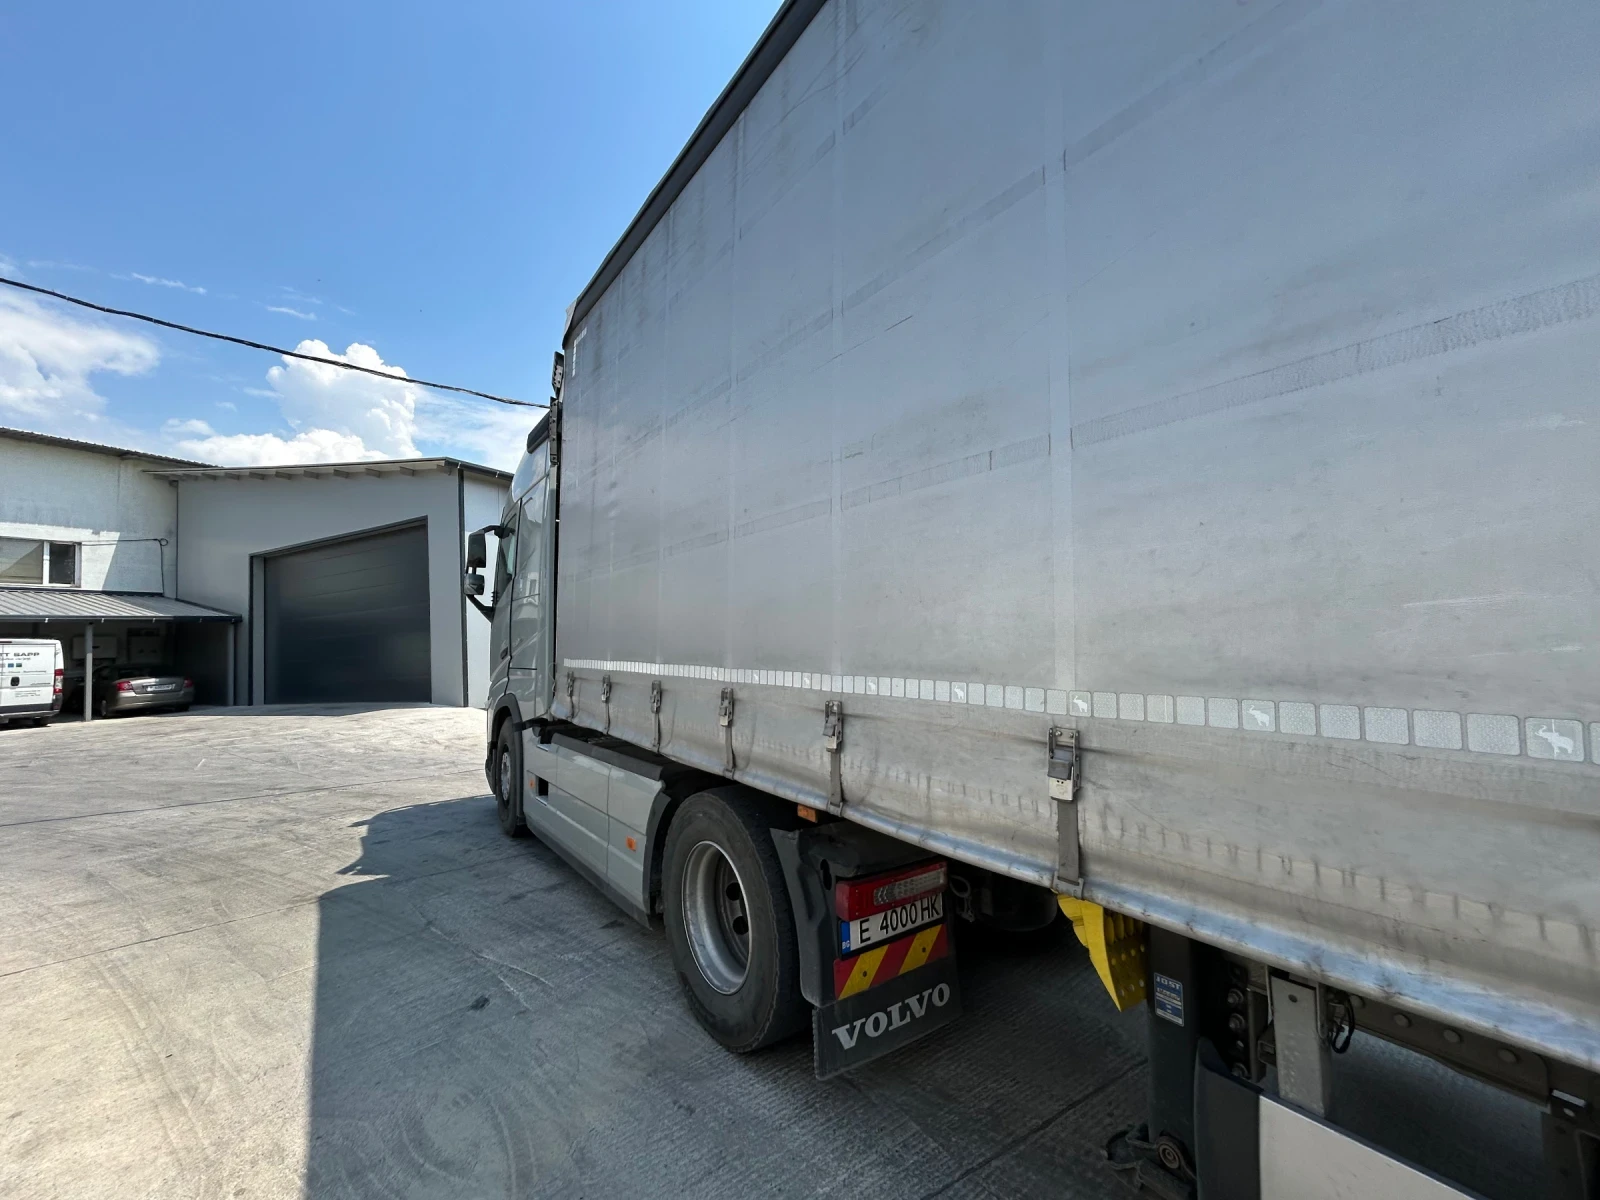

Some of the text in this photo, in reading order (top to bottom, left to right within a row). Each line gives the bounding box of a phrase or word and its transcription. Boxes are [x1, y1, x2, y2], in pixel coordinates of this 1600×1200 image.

[841, 940, 851, 950] BG
[1156, 976, 1181, 990] JOST
[831, 983, 951, 1051] VOLVO
